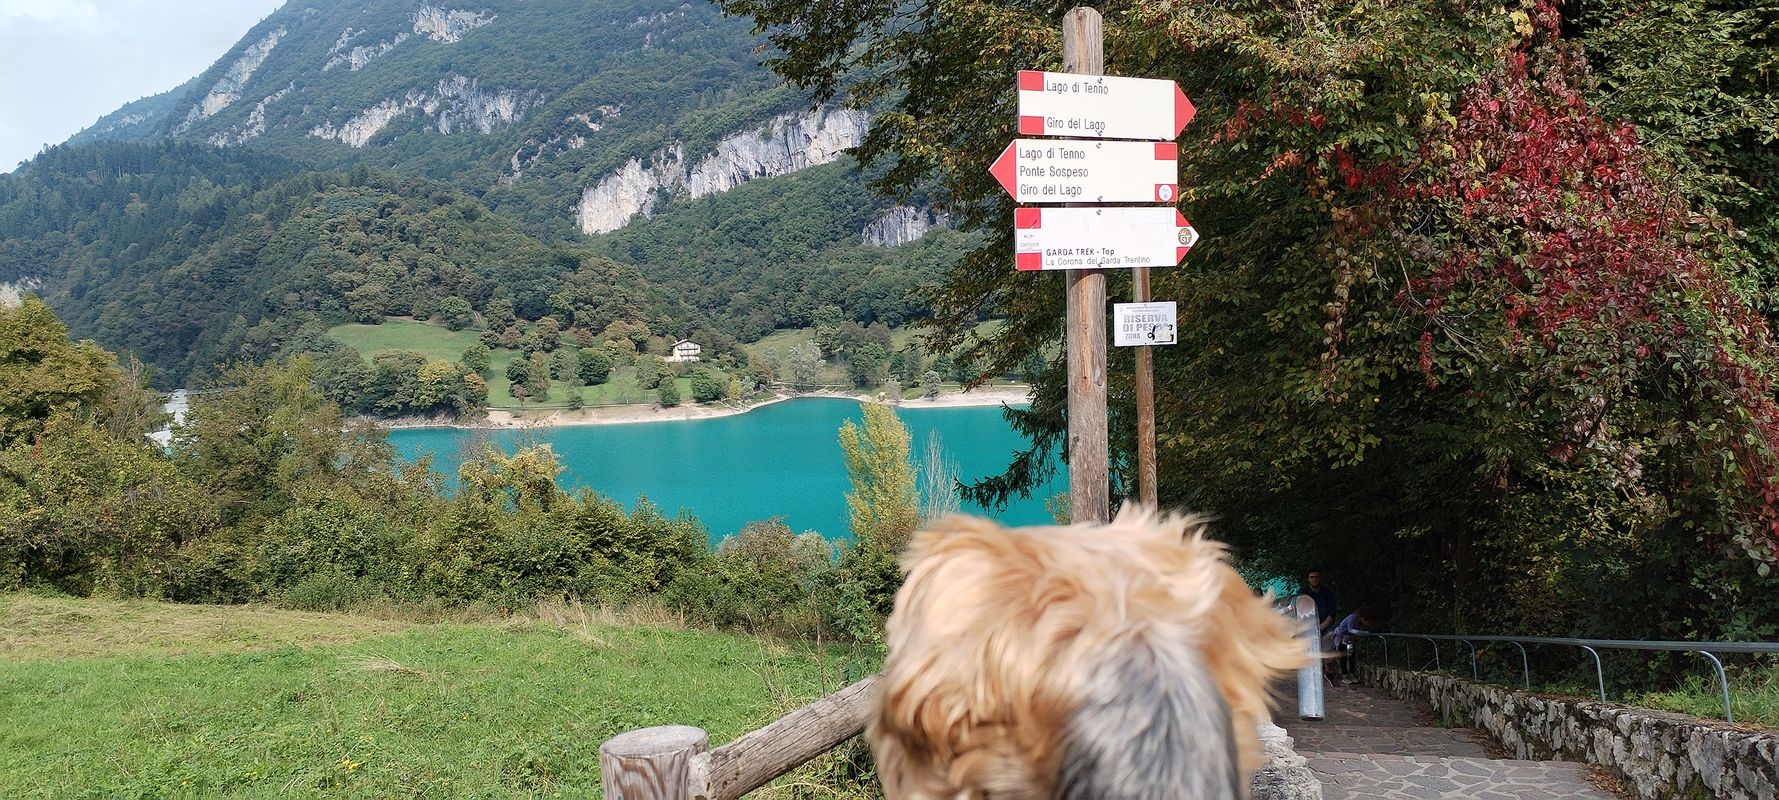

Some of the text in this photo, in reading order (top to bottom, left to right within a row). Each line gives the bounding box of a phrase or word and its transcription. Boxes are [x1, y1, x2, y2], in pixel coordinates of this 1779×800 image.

[1046, 80, 1108, 94] Lago di Tenno
[1046, 116, 1106, 133] Giro del Lago
[1020, 148, 1085, 161] Lago di Tenno
[1020, 166, 1088, 178] Ponte Sospeso
[1020, 184, 1082, 197] Giro del Lago
[1046, 248, 1074, 256] GARDA
[1102, 248, 1114, 256] Top
[1046, 258, 1054, 266] La
[1058, 258, 1082, 266] Corona
[1102, 256, 1120, 264] Garda
[1123, 314, 1168, 323] RISERVA
[1122, 324, 1134, 332] DI
